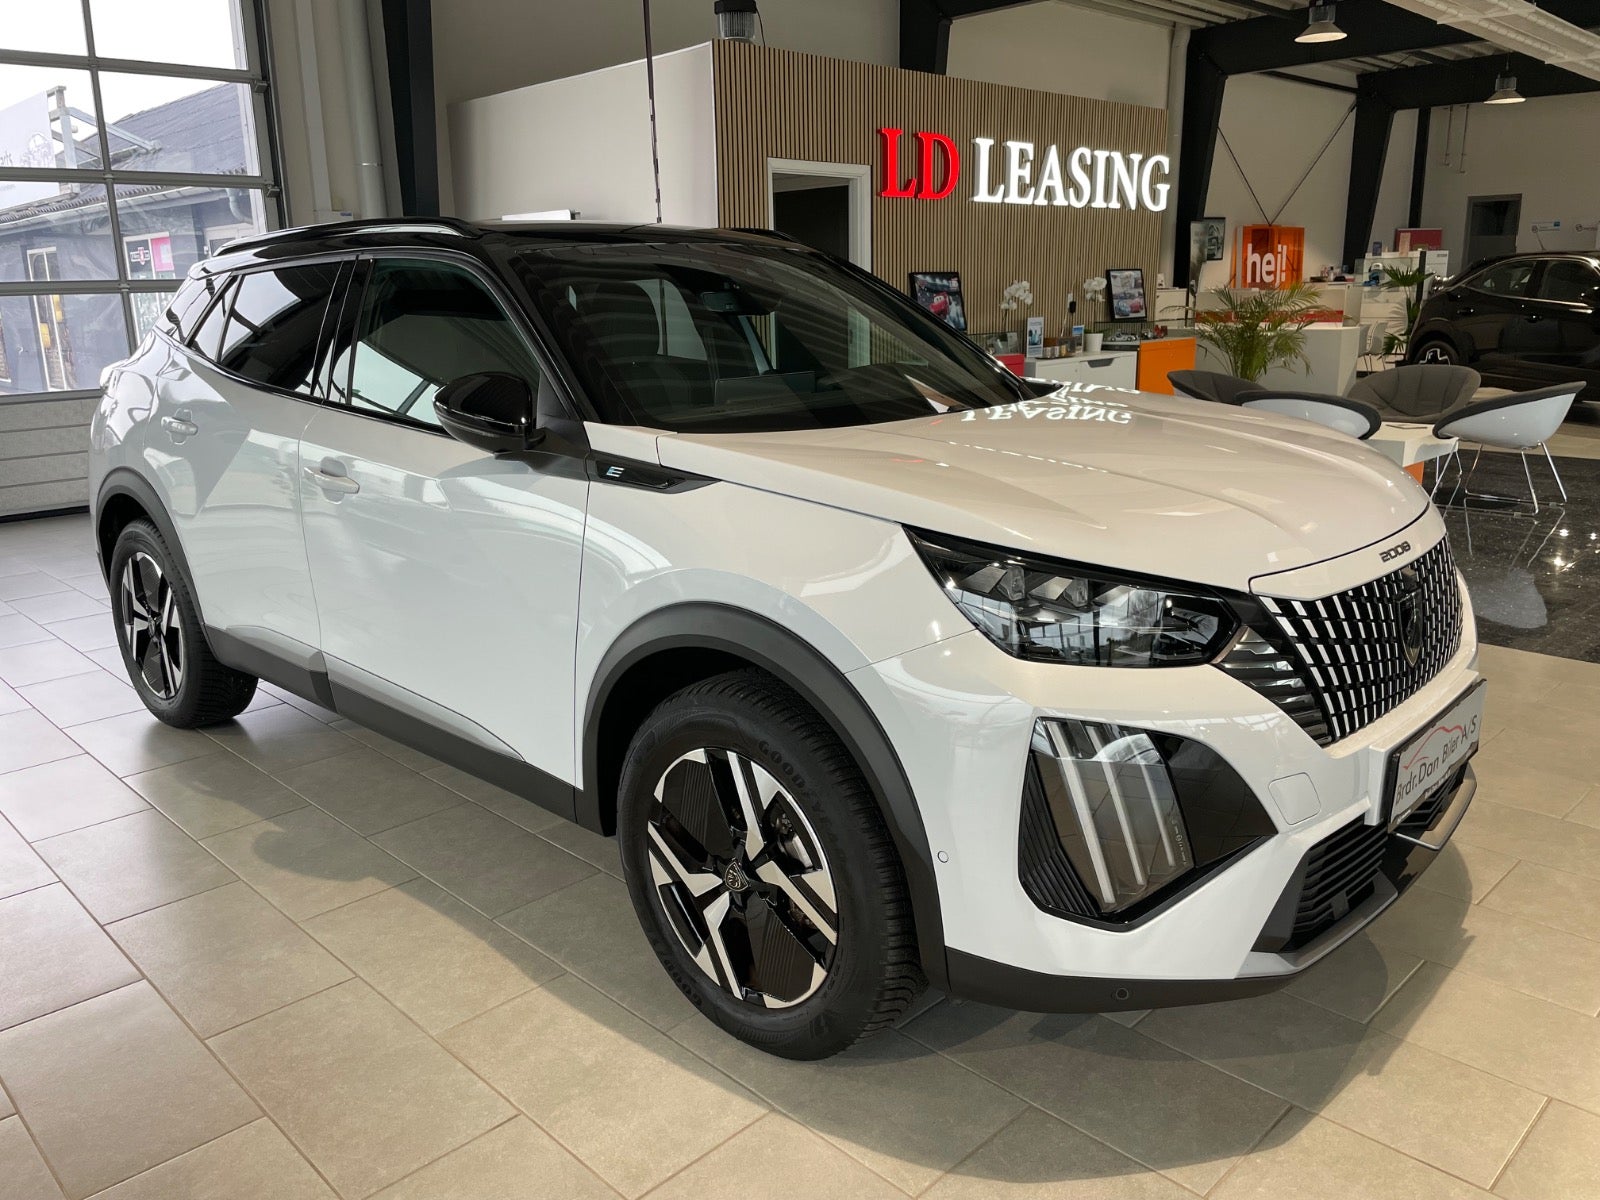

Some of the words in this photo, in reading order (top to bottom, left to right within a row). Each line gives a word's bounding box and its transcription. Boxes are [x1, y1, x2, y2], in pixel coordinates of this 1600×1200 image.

[877, 127, 960, 200] LD
[971, 137, 1171, 212] LEASING
[1247, 243, 1287, 289] hej!
[606, 466, 625, 478] E
[1379, 541, 1411, 563] 2008
[1461, 714, 1478, 744] A/S
